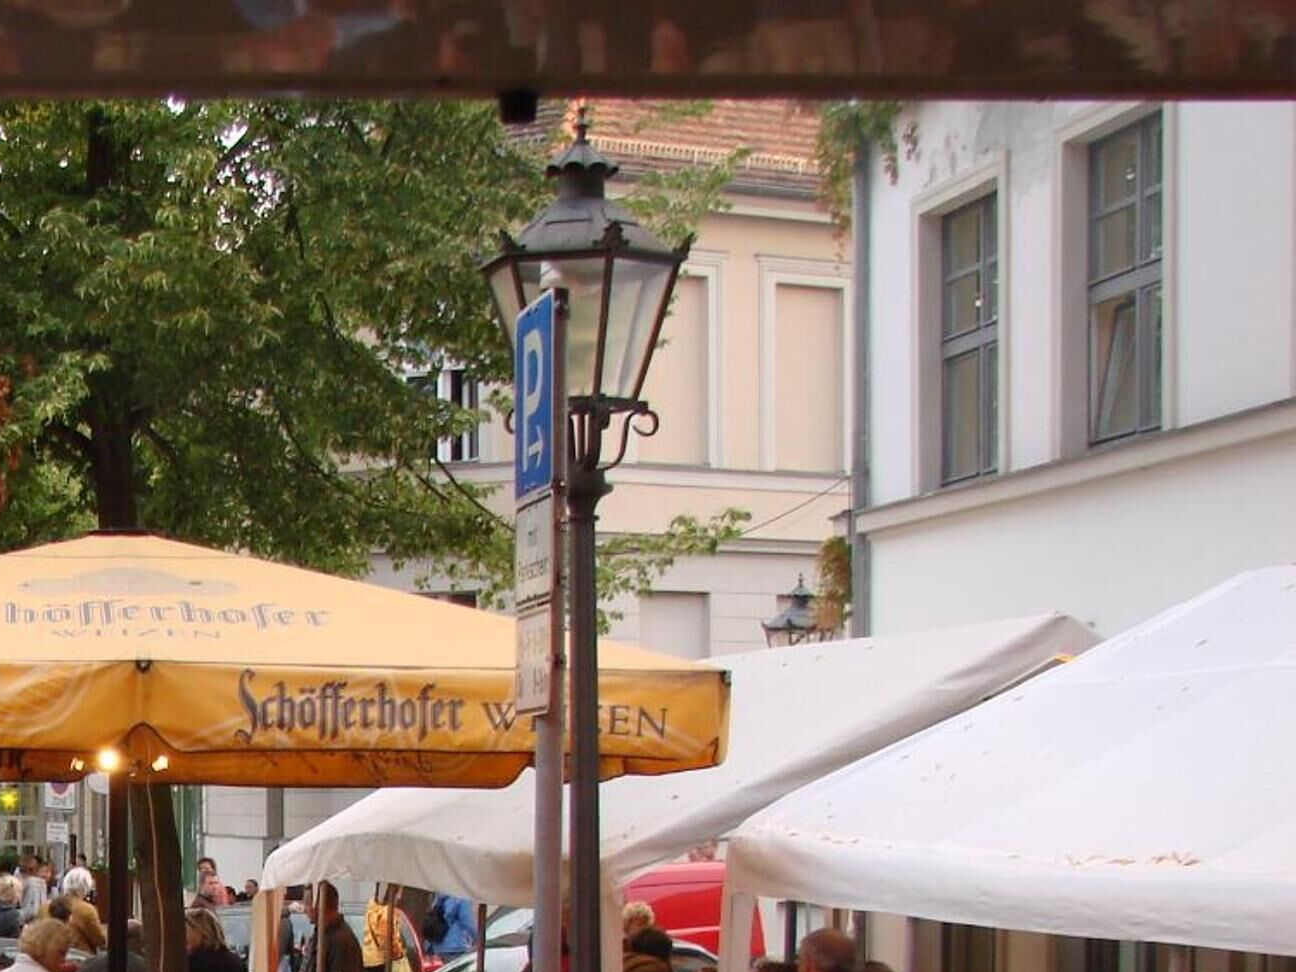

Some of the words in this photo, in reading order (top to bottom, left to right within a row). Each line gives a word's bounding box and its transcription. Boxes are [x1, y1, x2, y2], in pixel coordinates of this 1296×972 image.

[521, 329, 543, 472] P
[235, 668, 464, 744] Schöfferhofer
[481, 702, 668, 739] WIEN
